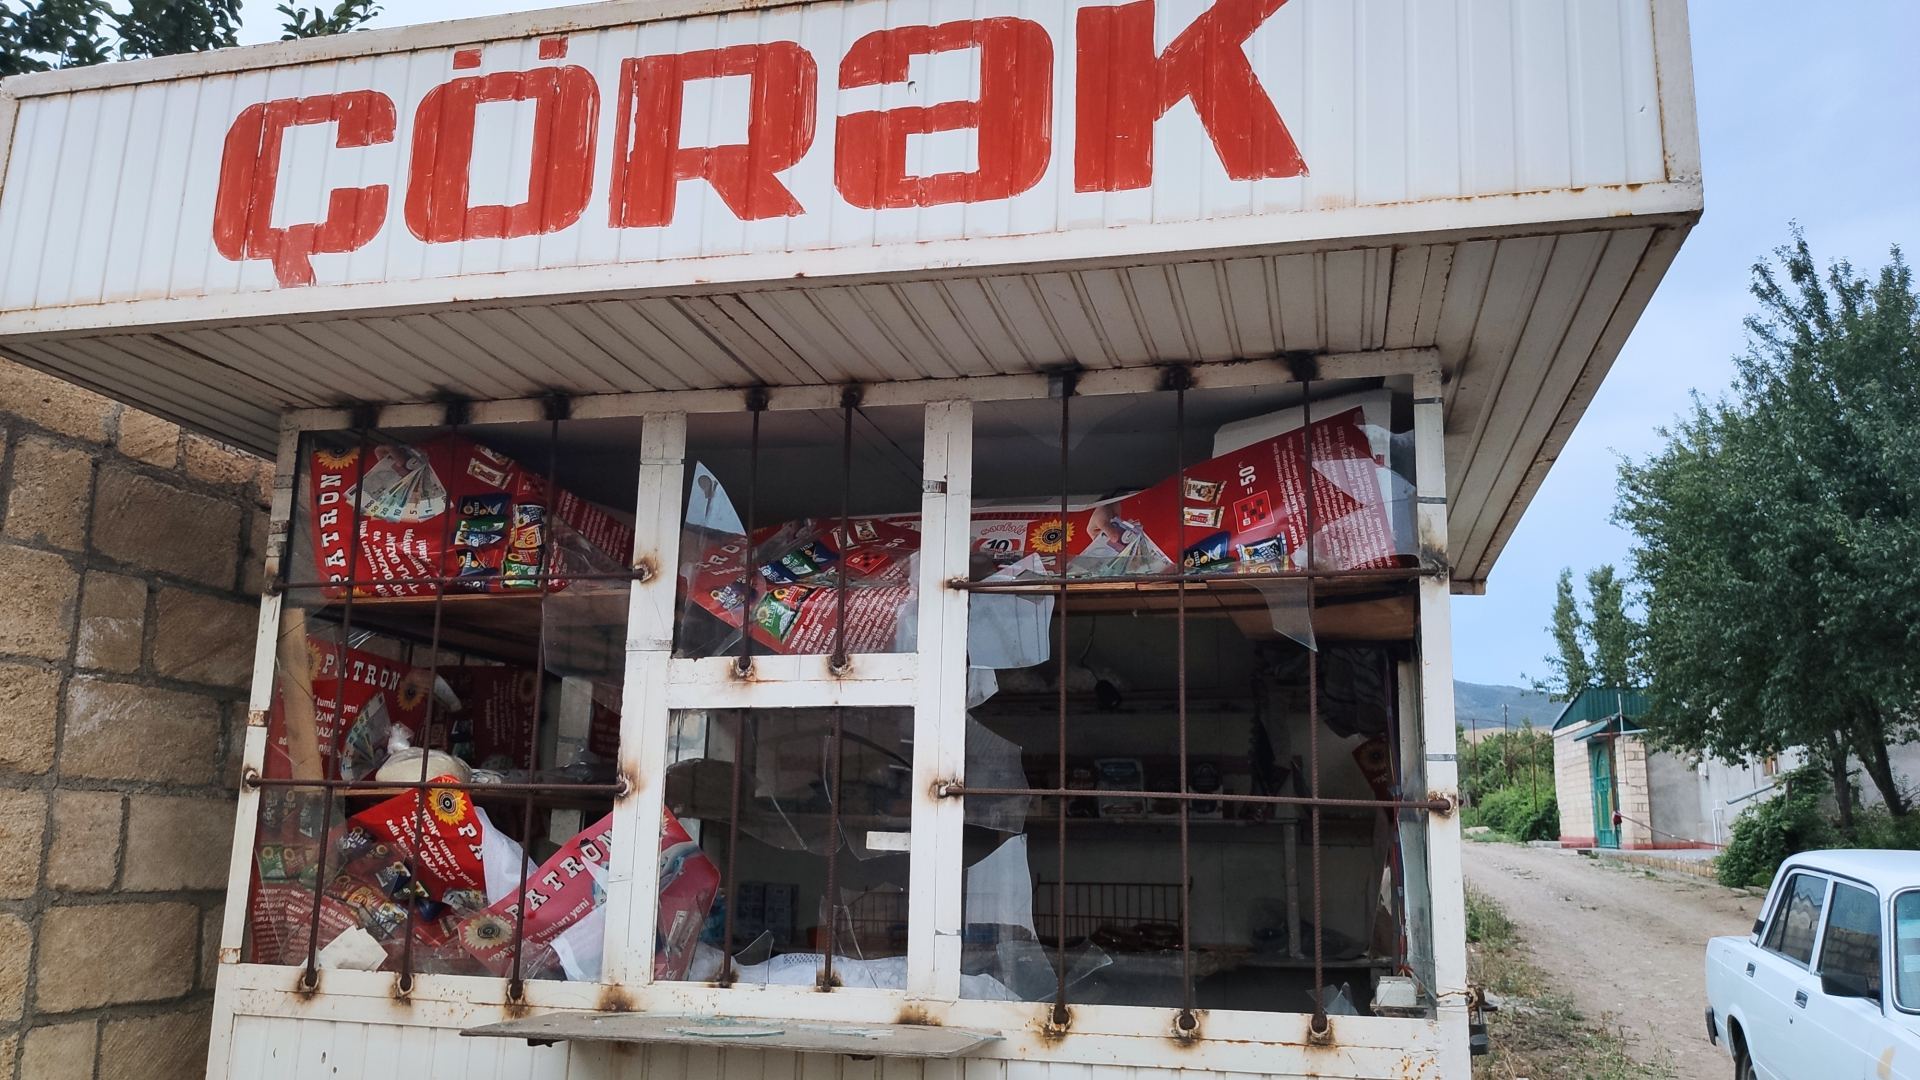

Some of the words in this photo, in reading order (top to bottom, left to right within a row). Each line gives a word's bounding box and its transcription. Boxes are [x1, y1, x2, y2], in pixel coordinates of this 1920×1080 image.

[1240, 464, 1254, 487] 50
[987, 538, 1009, 551] 10
[343, 704, 358, 712] yeni
[385, 818, 401, 836] adlı
[418, 849, 447, 884] QAZAN"
[421, 833, 448, 870] QAZAN"
[445, 869, 455, 880] və
[437, 838, 461, 871] tumları
[456, 871, 477, 887] yeni
[536, 914, 570, 939] tumları
[569, 896, 590, 919] yeni
